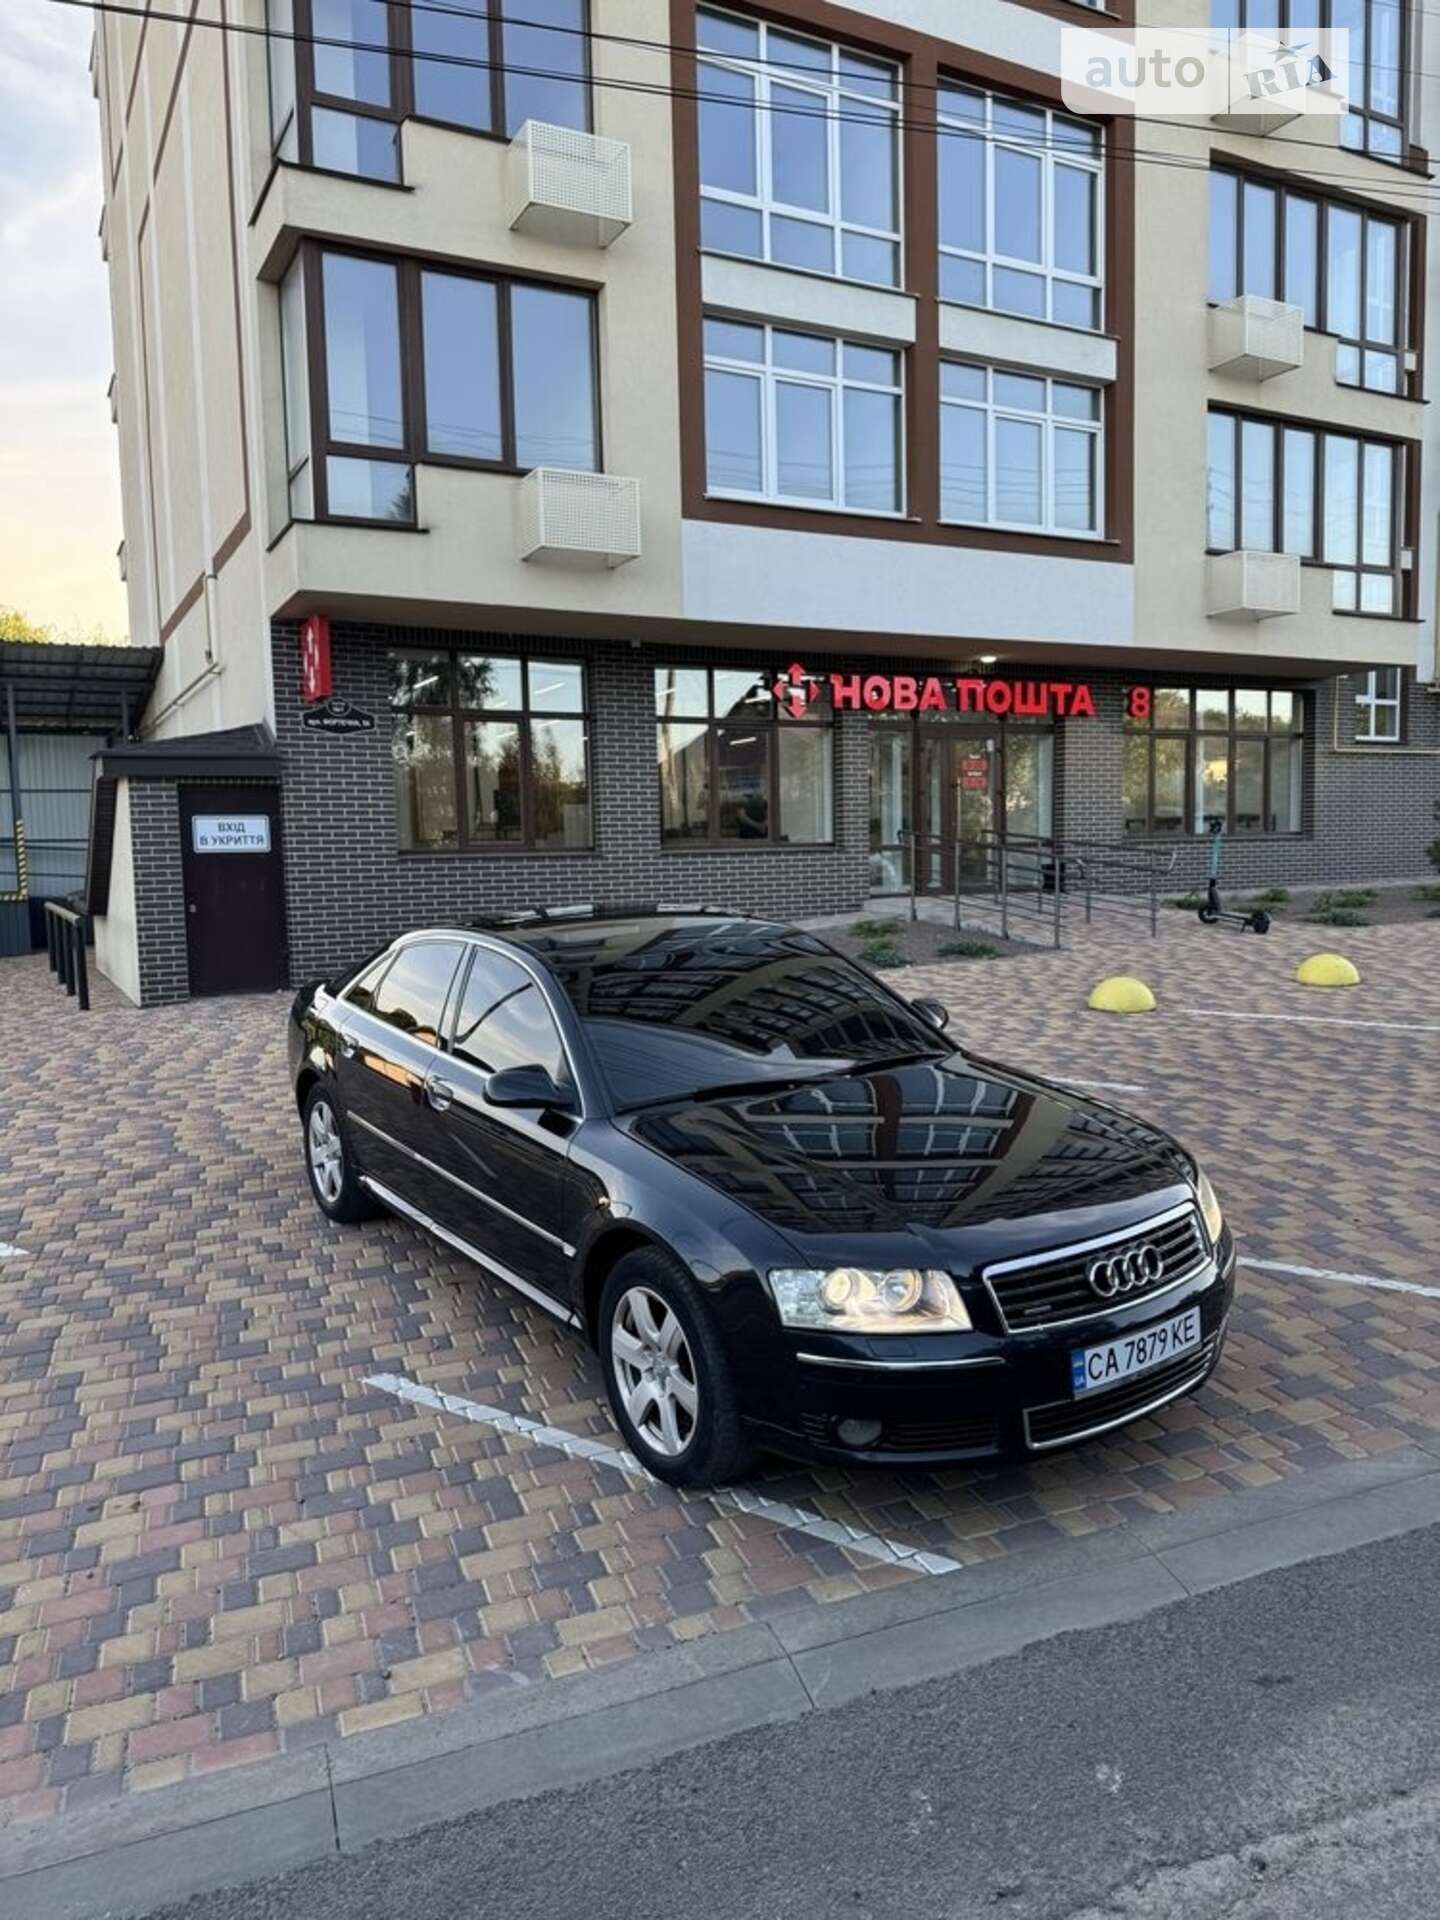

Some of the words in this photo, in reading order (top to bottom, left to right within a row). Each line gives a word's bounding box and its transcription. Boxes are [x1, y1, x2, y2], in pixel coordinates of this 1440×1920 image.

[830, 674, 948, 712] НОВА
[956, 678, 1095, 716] ПОШТА
[1127, 686, 1151, 719] 8
[211, 834, 264, 846] УКРИТТЯ
[217, 822, 246, 833] ВХІД
[1087, 1347, 1119, 1380] CA
[1124, 1328, 1168, 1370] 7879
[1171, 1314, 1195, 1349] KE
